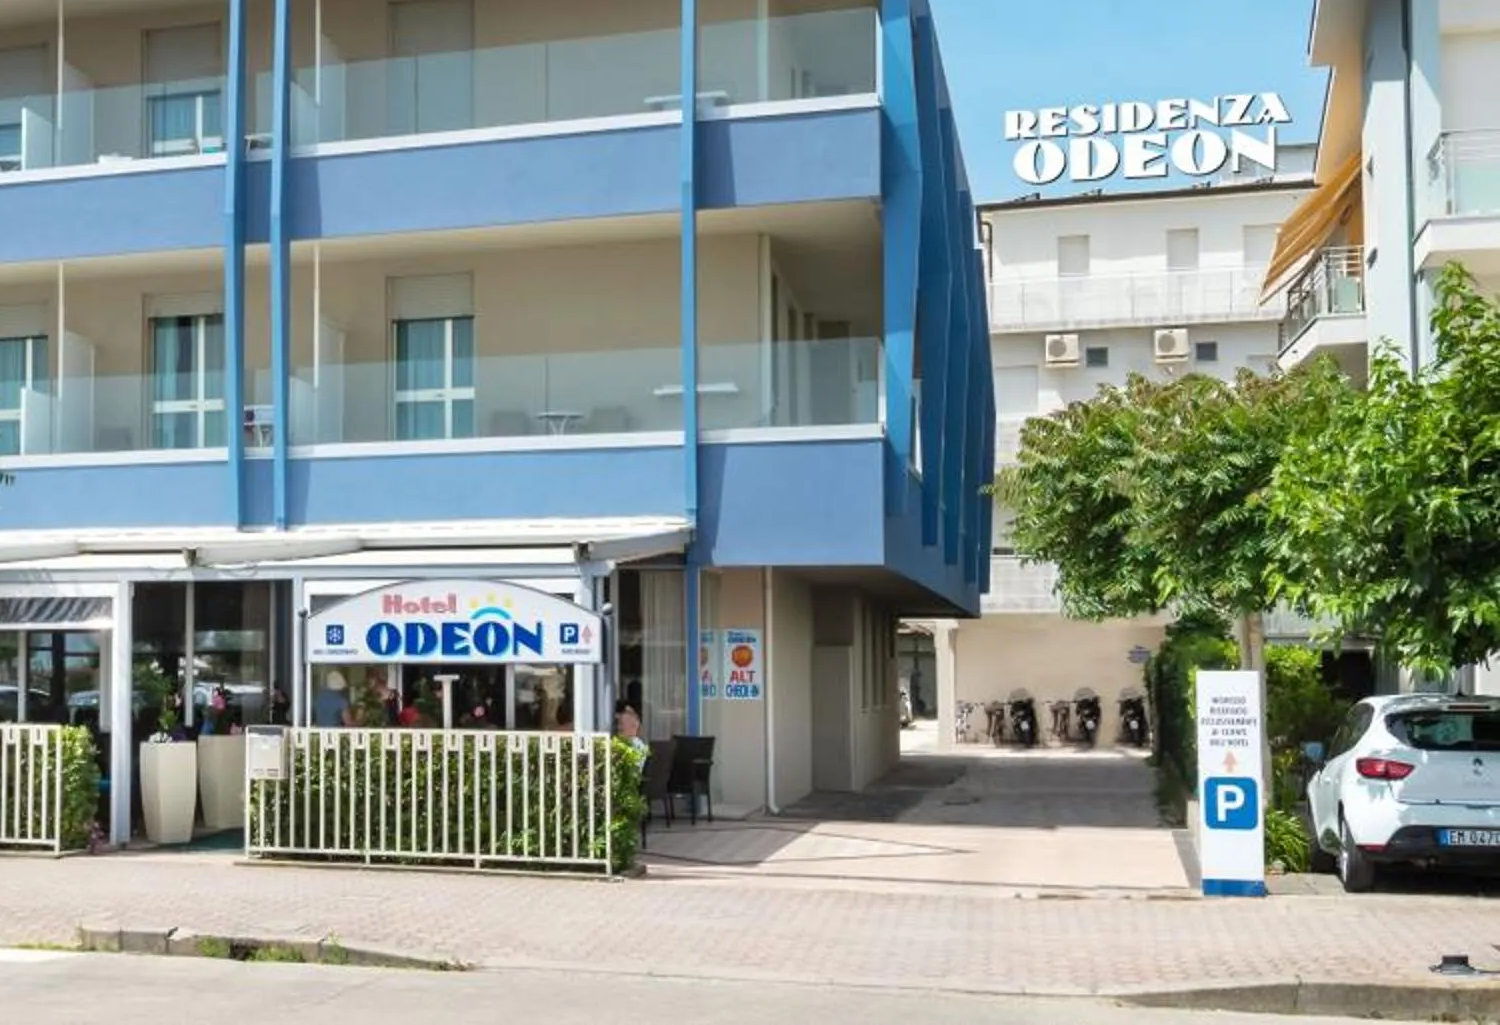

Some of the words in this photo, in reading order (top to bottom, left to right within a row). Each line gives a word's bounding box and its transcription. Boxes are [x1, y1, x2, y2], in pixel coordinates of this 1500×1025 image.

[1005, 92, 1292, 141] RESIDENZA
[1013, 126, 1276, 185] ODEON
[383, 593, 457, 614] Hotel
[365, 620, 543, 656] ODEON
[563, 626, 576, 642] P
[1216, 783, 1245, 822] P
